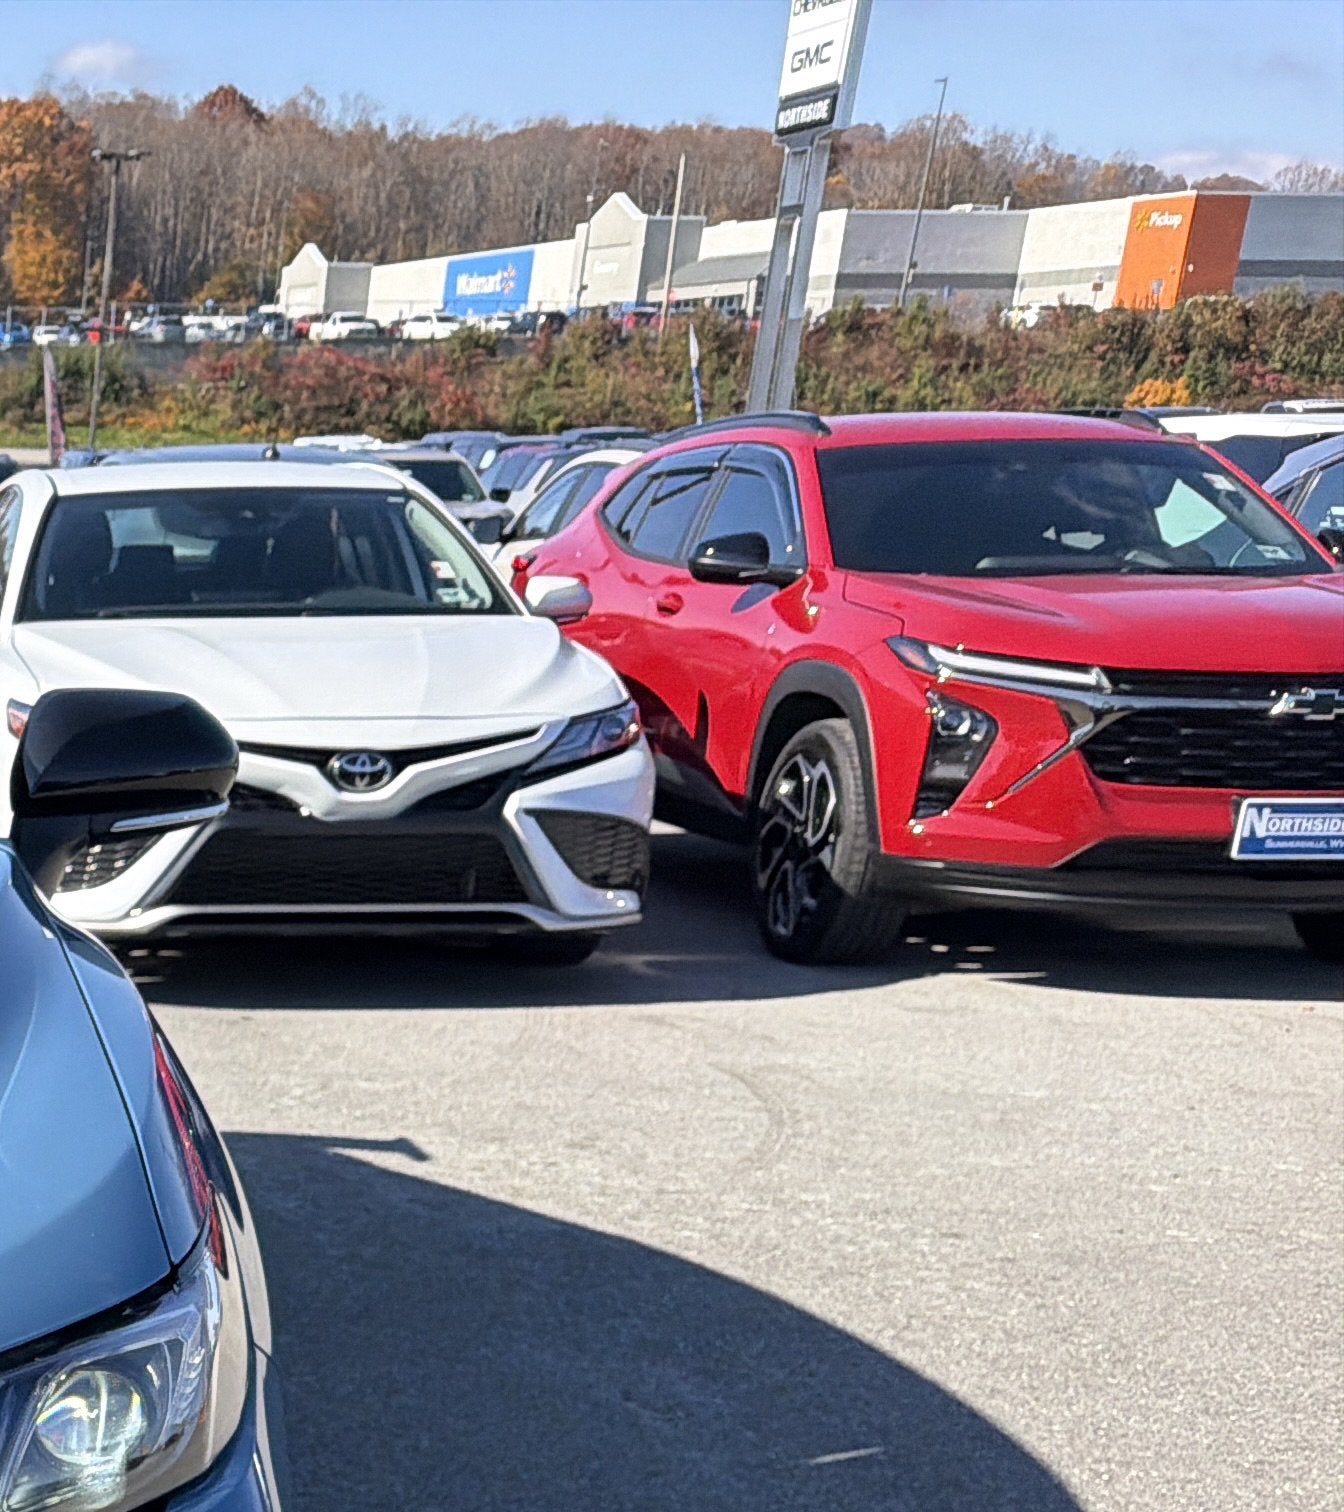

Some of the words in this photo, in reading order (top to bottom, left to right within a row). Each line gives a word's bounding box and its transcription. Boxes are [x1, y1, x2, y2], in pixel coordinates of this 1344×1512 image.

[791, 40, 834, 73] GMC
[778, 98, 831, 129] NORTHSIDE
[1148, 210, 1184, 230] Pickup
[456, 265, 502, 296] Walmart
[1242, 807, 1344, 838] NORTHSID
